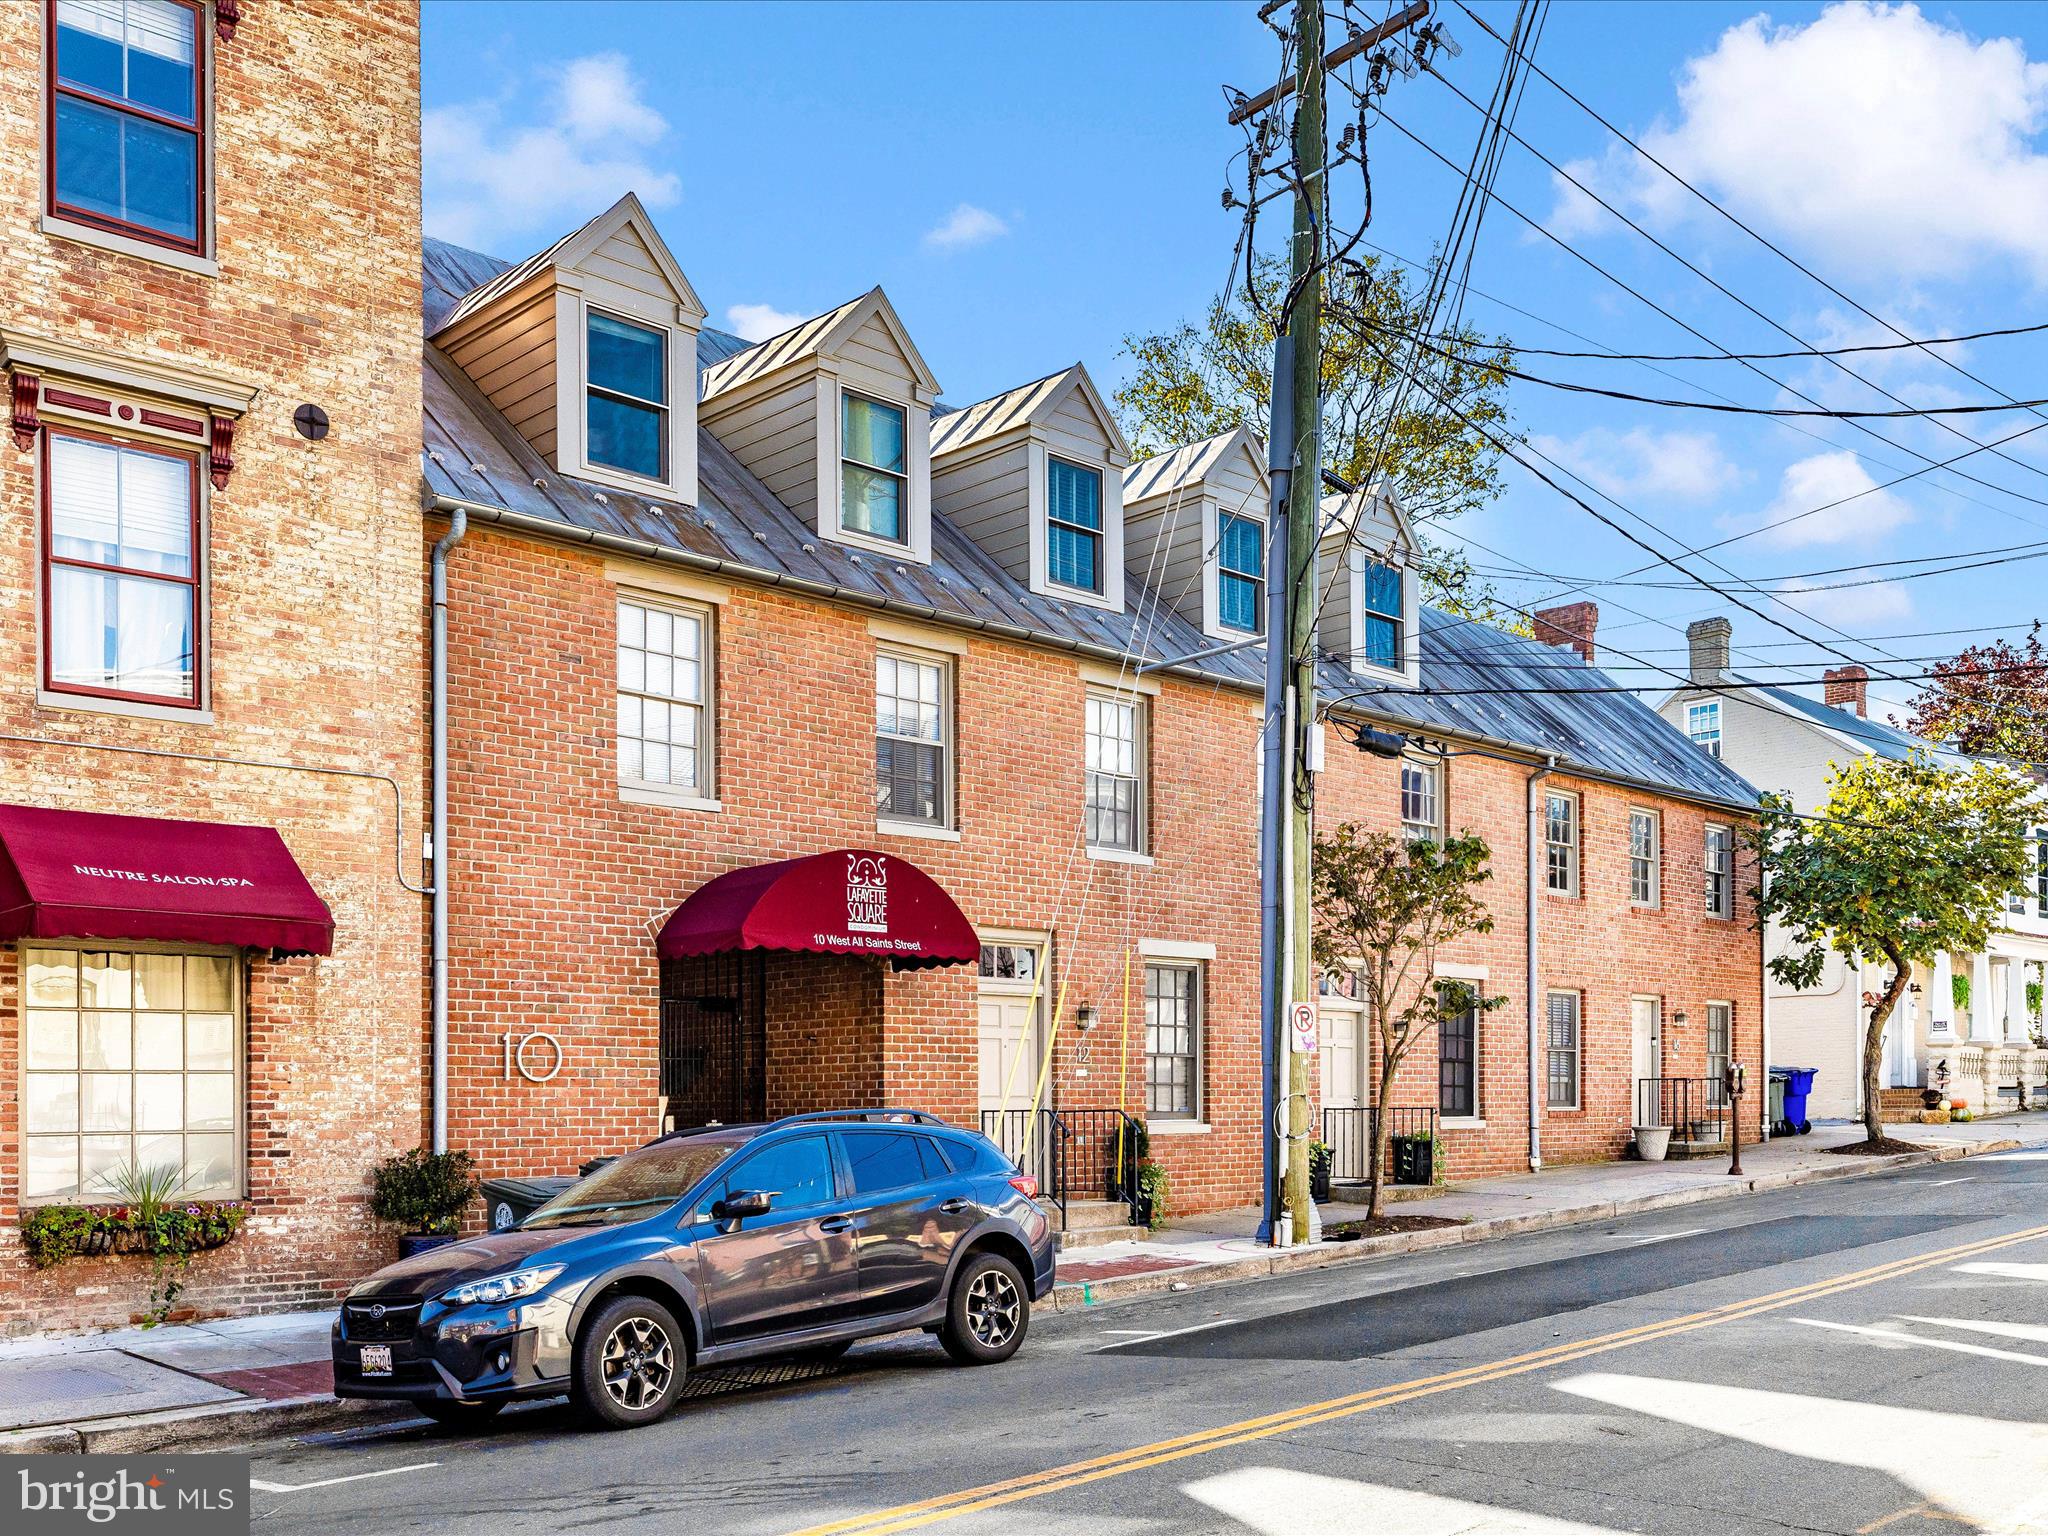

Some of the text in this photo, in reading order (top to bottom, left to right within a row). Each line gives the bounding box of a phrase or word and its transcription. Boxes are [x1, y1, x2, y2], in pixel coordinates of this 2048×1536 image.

[73, 865, 255, 887] NEUTRE SALON/SPA
[847, 886, 887, 904] LAFAYETTE
[847, 902, 888, 924] SQUARE
[813, 933, 921, 951] 10 West All Saints Street
[503, 1032, 562, 1082] 10
[1077, 1047, 1091, 1062] 12
